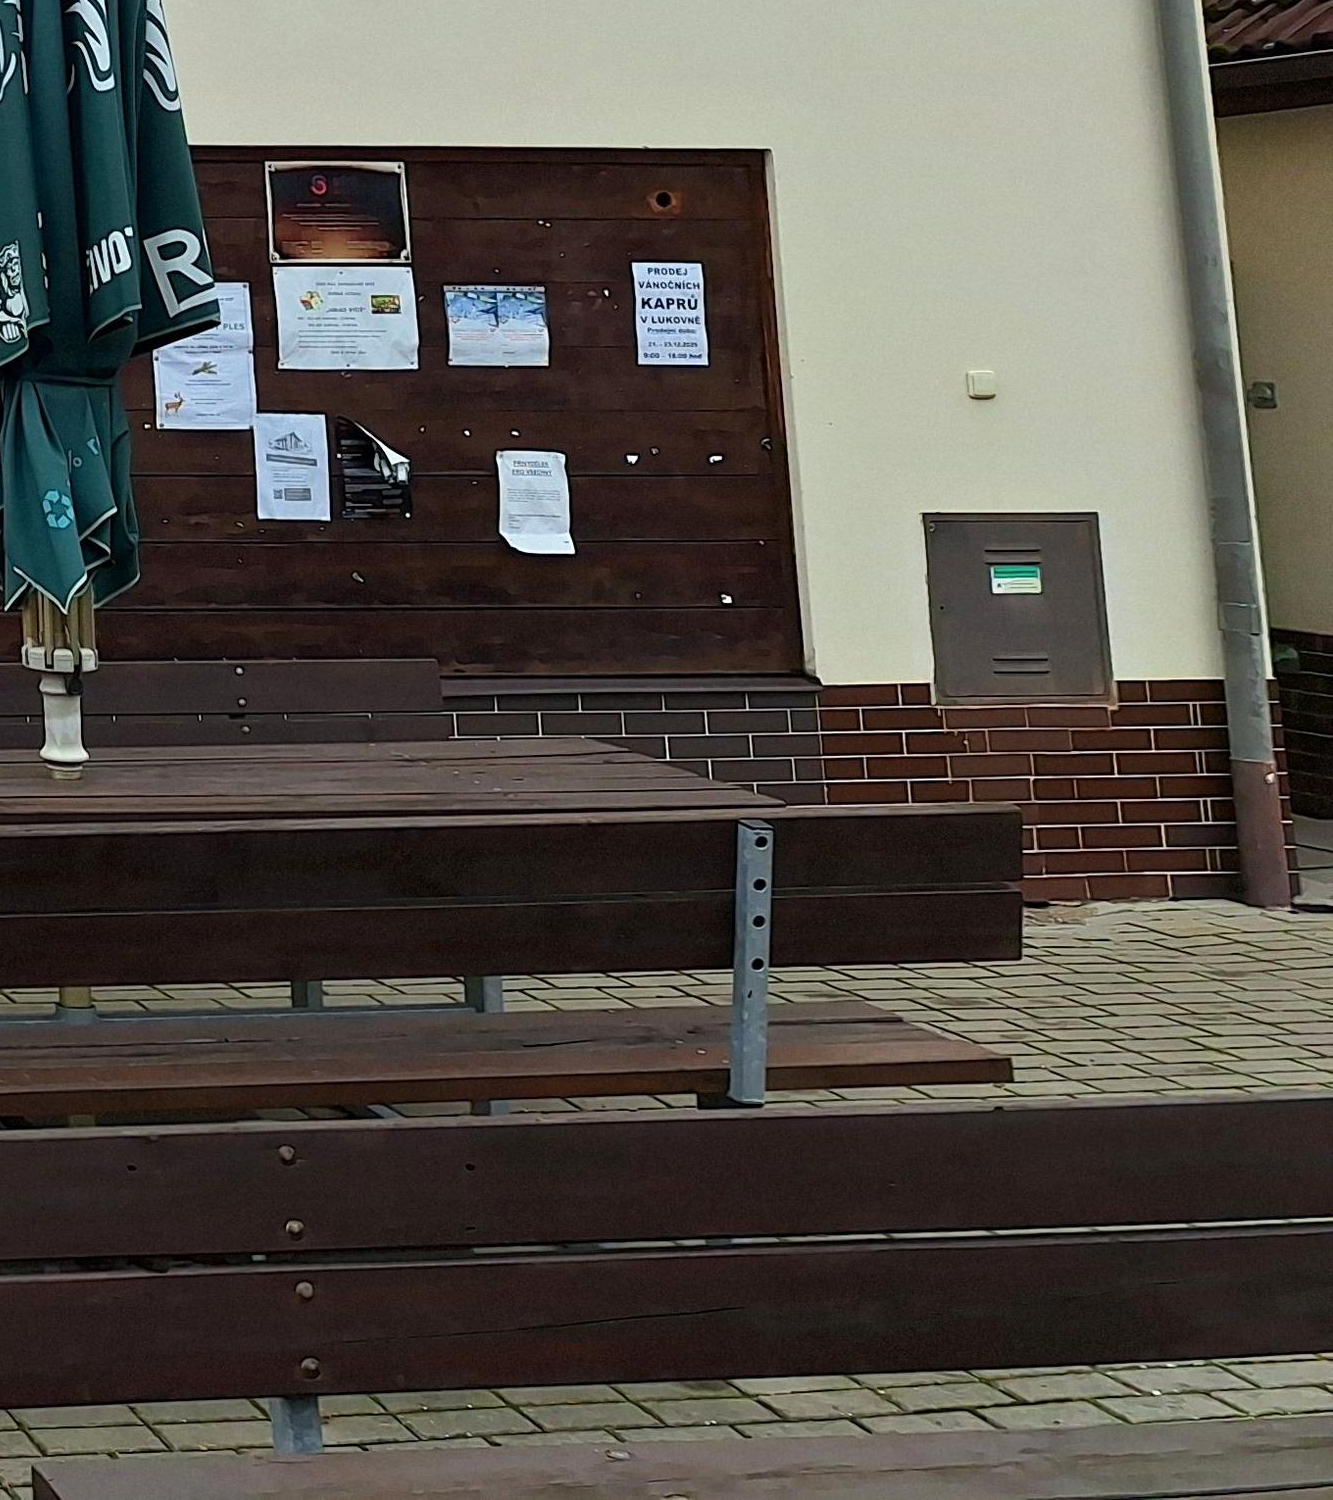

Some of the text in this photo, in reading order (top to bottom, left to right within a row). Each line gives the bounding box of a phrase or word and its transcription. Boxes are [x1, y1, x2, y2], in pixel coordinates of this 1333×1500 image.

[647, 267, 688, 276] PRODEJ
[638, 281, 701, 290] VÁNOČNÍCH
[641, 293, 699, 311] KAPRŮ
[640, 315, 648, 324] V
[223, 322, 245, 331] PLES
